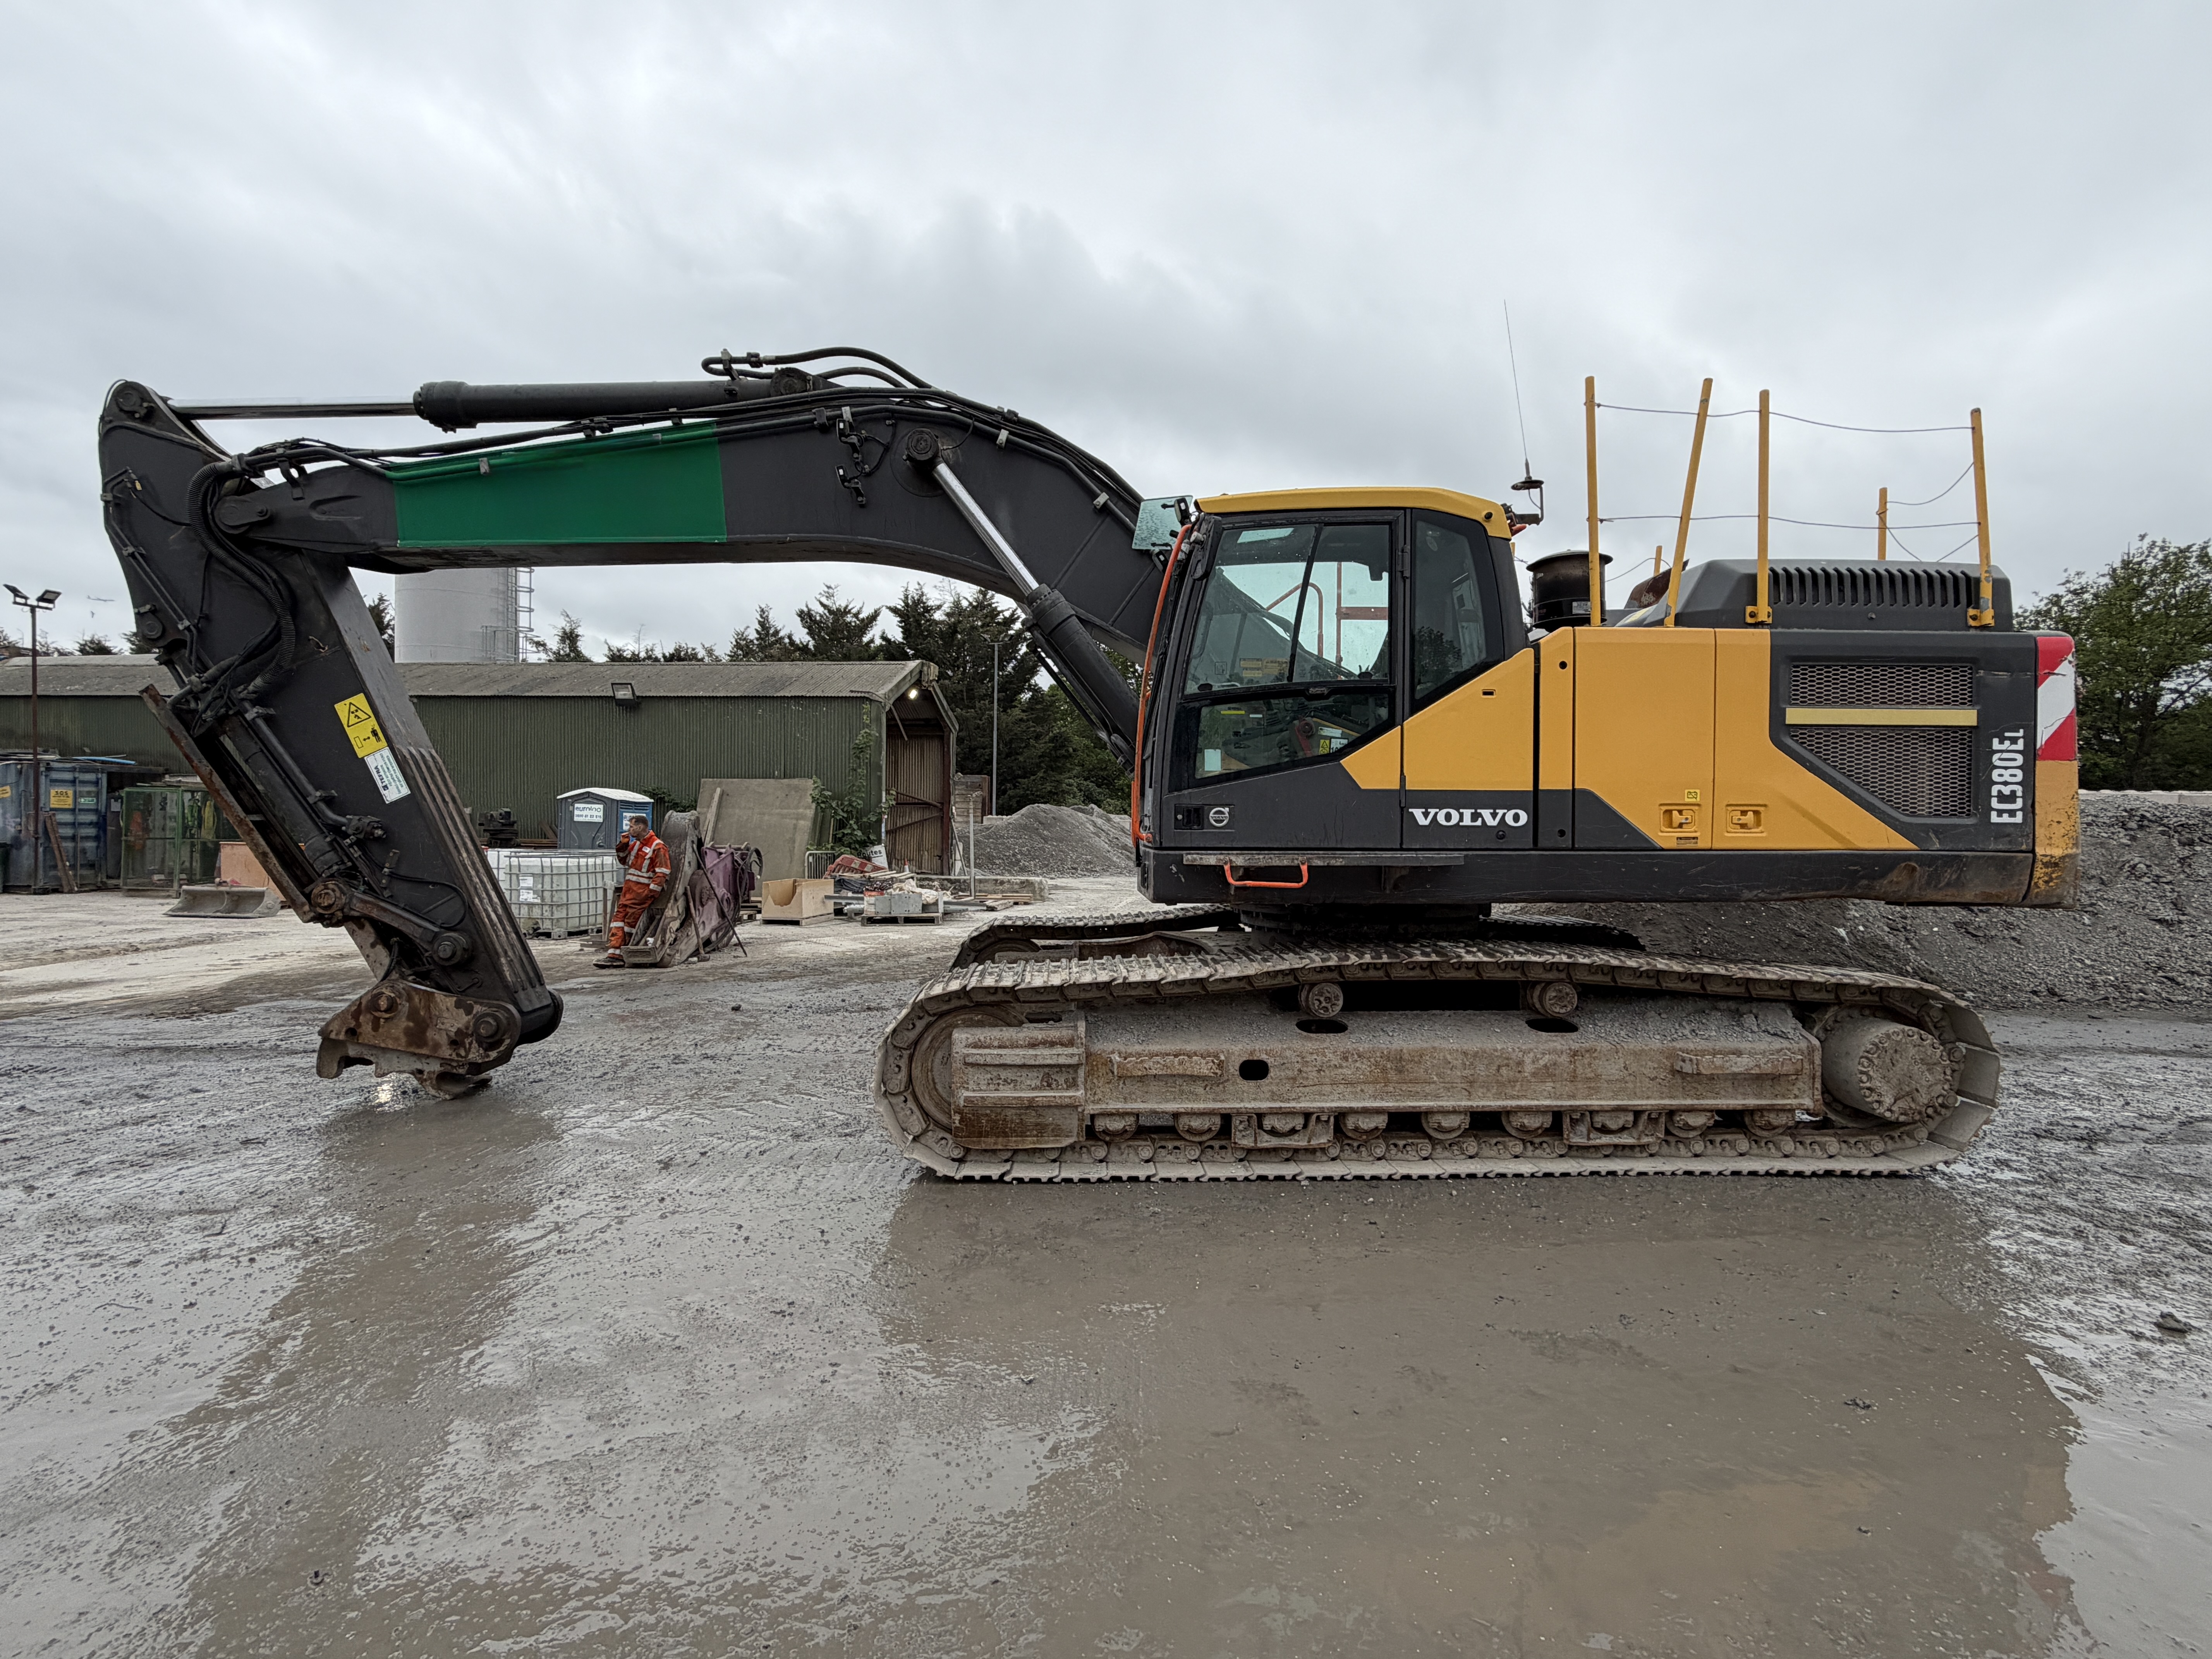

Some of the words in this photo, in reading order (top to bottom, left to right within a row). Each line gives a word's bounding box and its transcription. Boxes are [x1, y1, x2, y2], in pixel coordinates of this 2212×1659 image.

[374, 765, 385, 785] TEFRA
[1990, 729, 2024, 823] EC380EL
[1409, 808, 1528, 826] VOLVO
